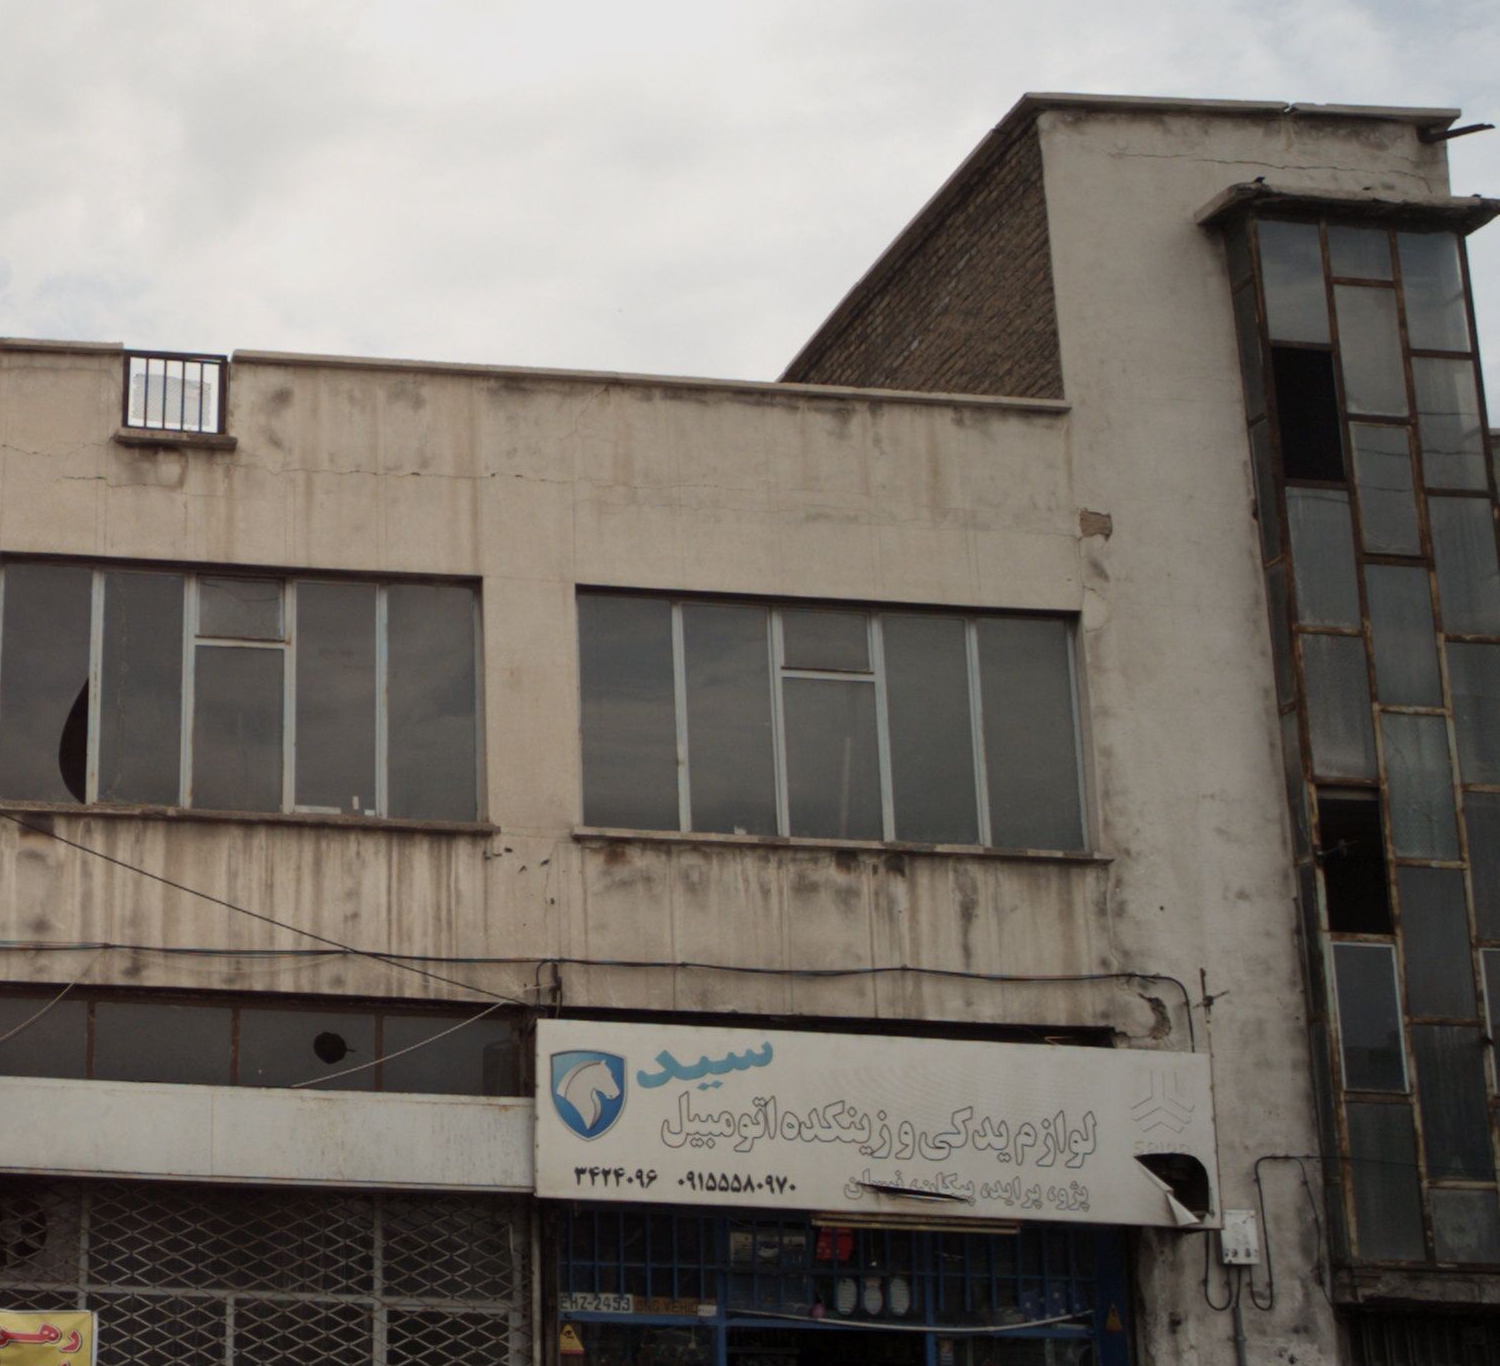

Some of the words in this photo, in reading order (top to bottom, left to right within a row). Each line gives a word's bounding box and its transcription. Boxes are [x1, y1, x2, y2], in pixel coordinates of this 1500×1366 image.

[636, 1040, 773, 1091] سید
[660, 1090, 778, 1153] اتومبیل
[895, 1120, 915, 1160] و
[918, 1105, 1012, 1163] یدکی
[1013, 1109, 1098, 1169] لوازم
